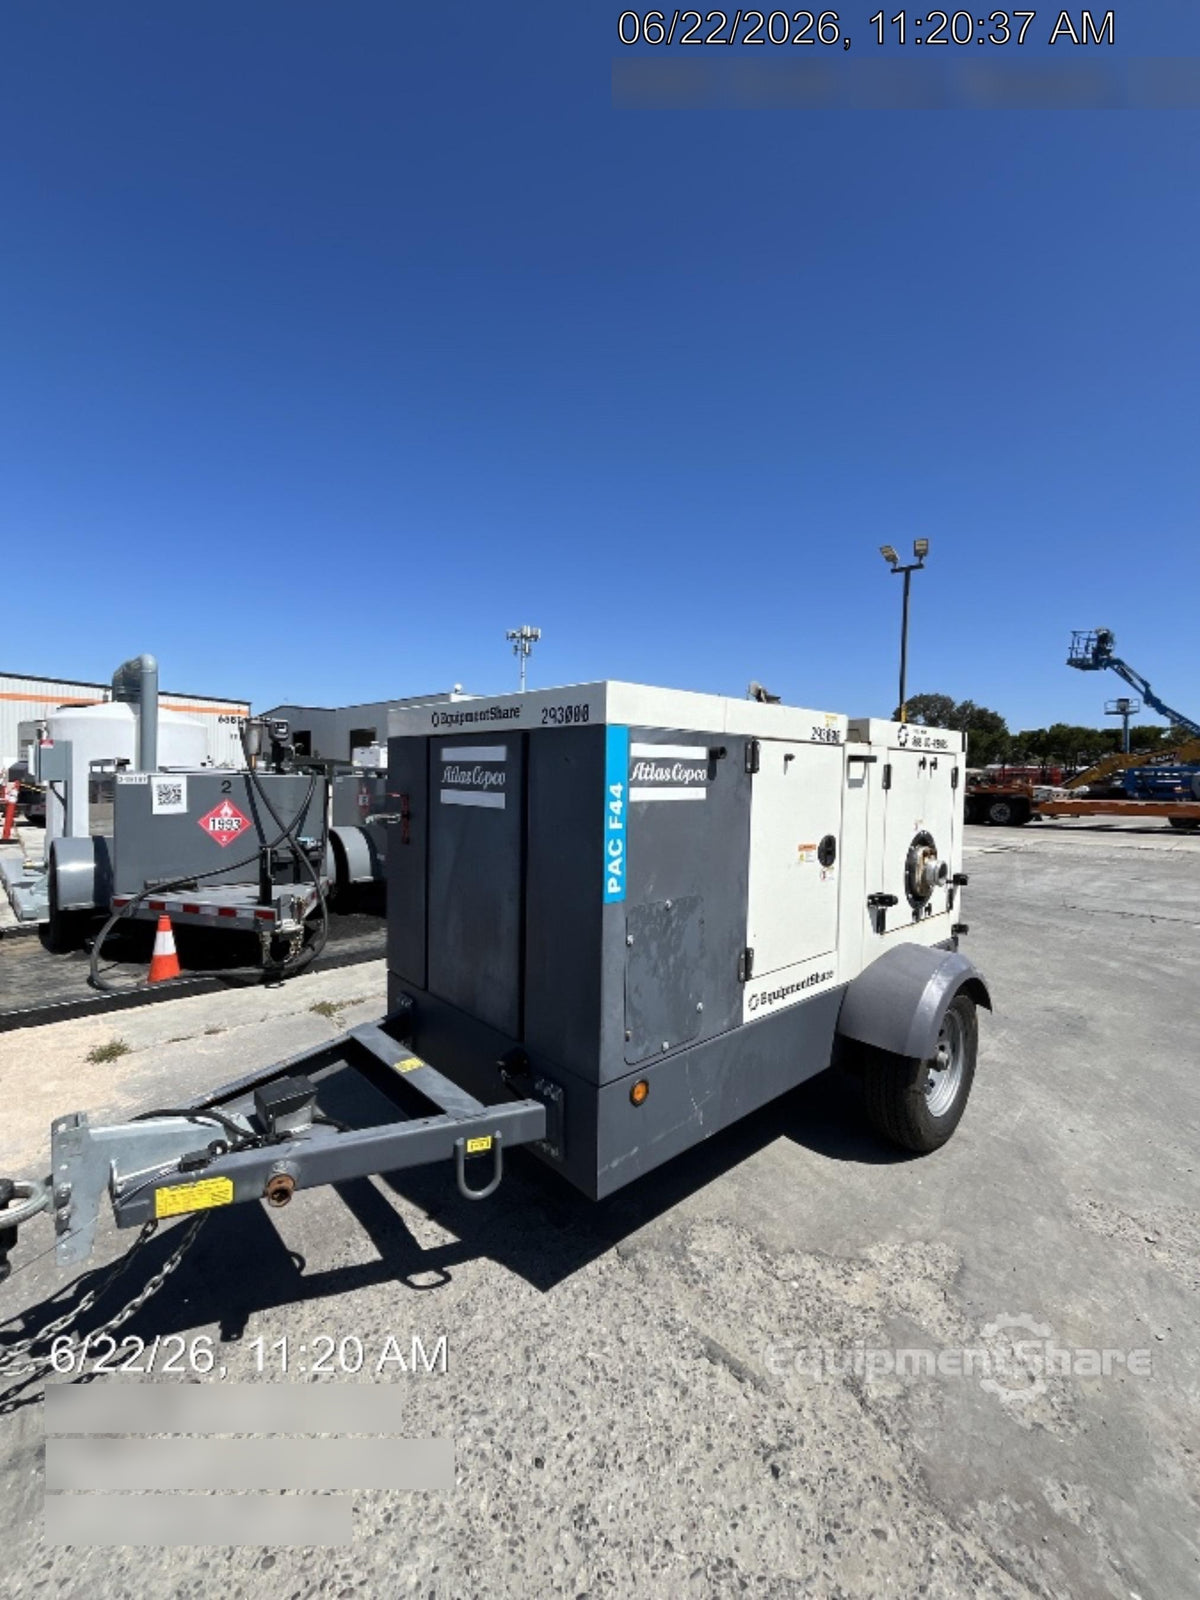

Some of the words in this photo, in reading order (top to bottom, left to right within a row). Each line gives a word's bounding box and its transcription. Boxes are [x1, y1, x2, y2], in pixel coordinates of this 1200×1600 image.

[440, 704, 521, 727] EquipmentShare
[441, 765, 472, 785] Atlas
[472, 765, 506, 790] Copco
[629, 761, 671, 782] Atlas
[671, 762, 707, 784] Copco
[221, 780, 232, 794] 2
[608, 782, 624, 830] F44
[210, 818, 241, 831] 1993
[607, 838, 624, 894] PAC
